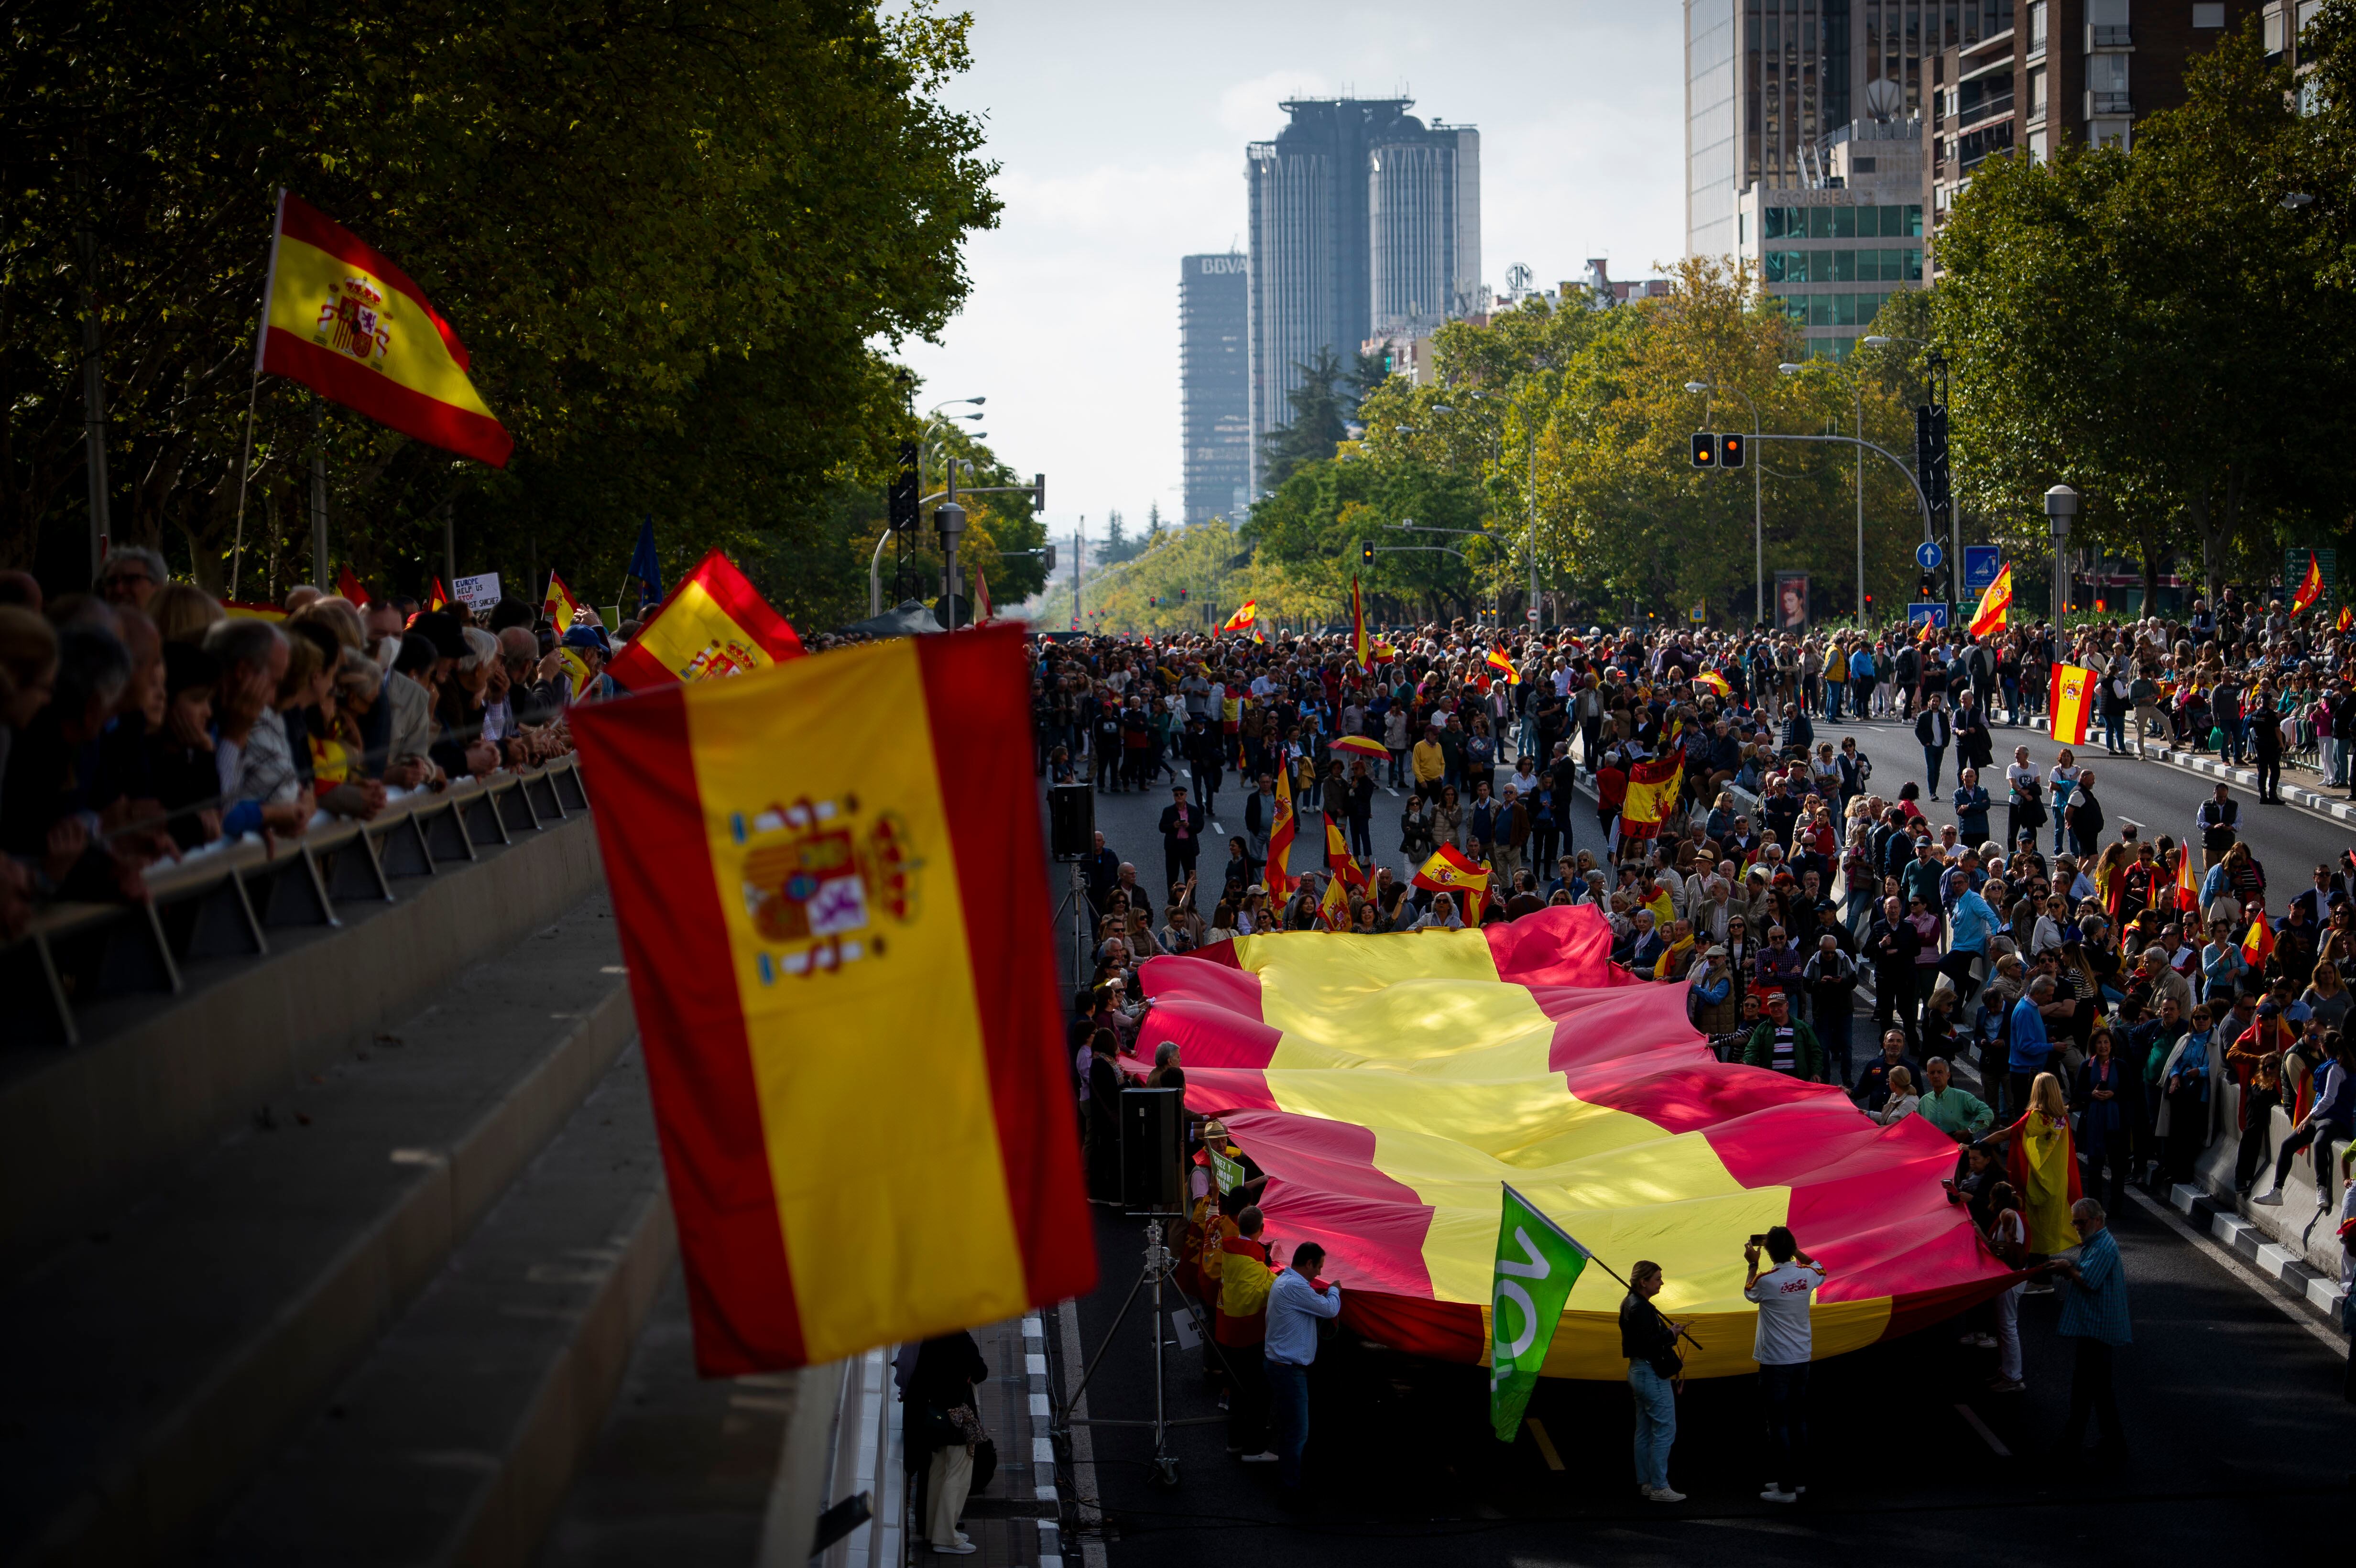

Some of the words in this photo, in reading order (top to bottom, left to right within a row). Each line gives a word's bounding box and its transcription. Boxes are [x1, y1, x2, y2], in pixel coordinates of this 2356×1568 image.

[1773, 190, 1855, 206] GORBEA
[1864, 190, 1875, 206] 2
[1201, 258, 1247, 274] BBVA
[456, 578, 479, 588] EUROPE
[457, 586, 472, 595] HELP
[1213, 1154, 1225, 1170] CHEZ
[1228, 1164, 1232, 1173] Y
[1217, 1168, 1233, 1184] EMONT
